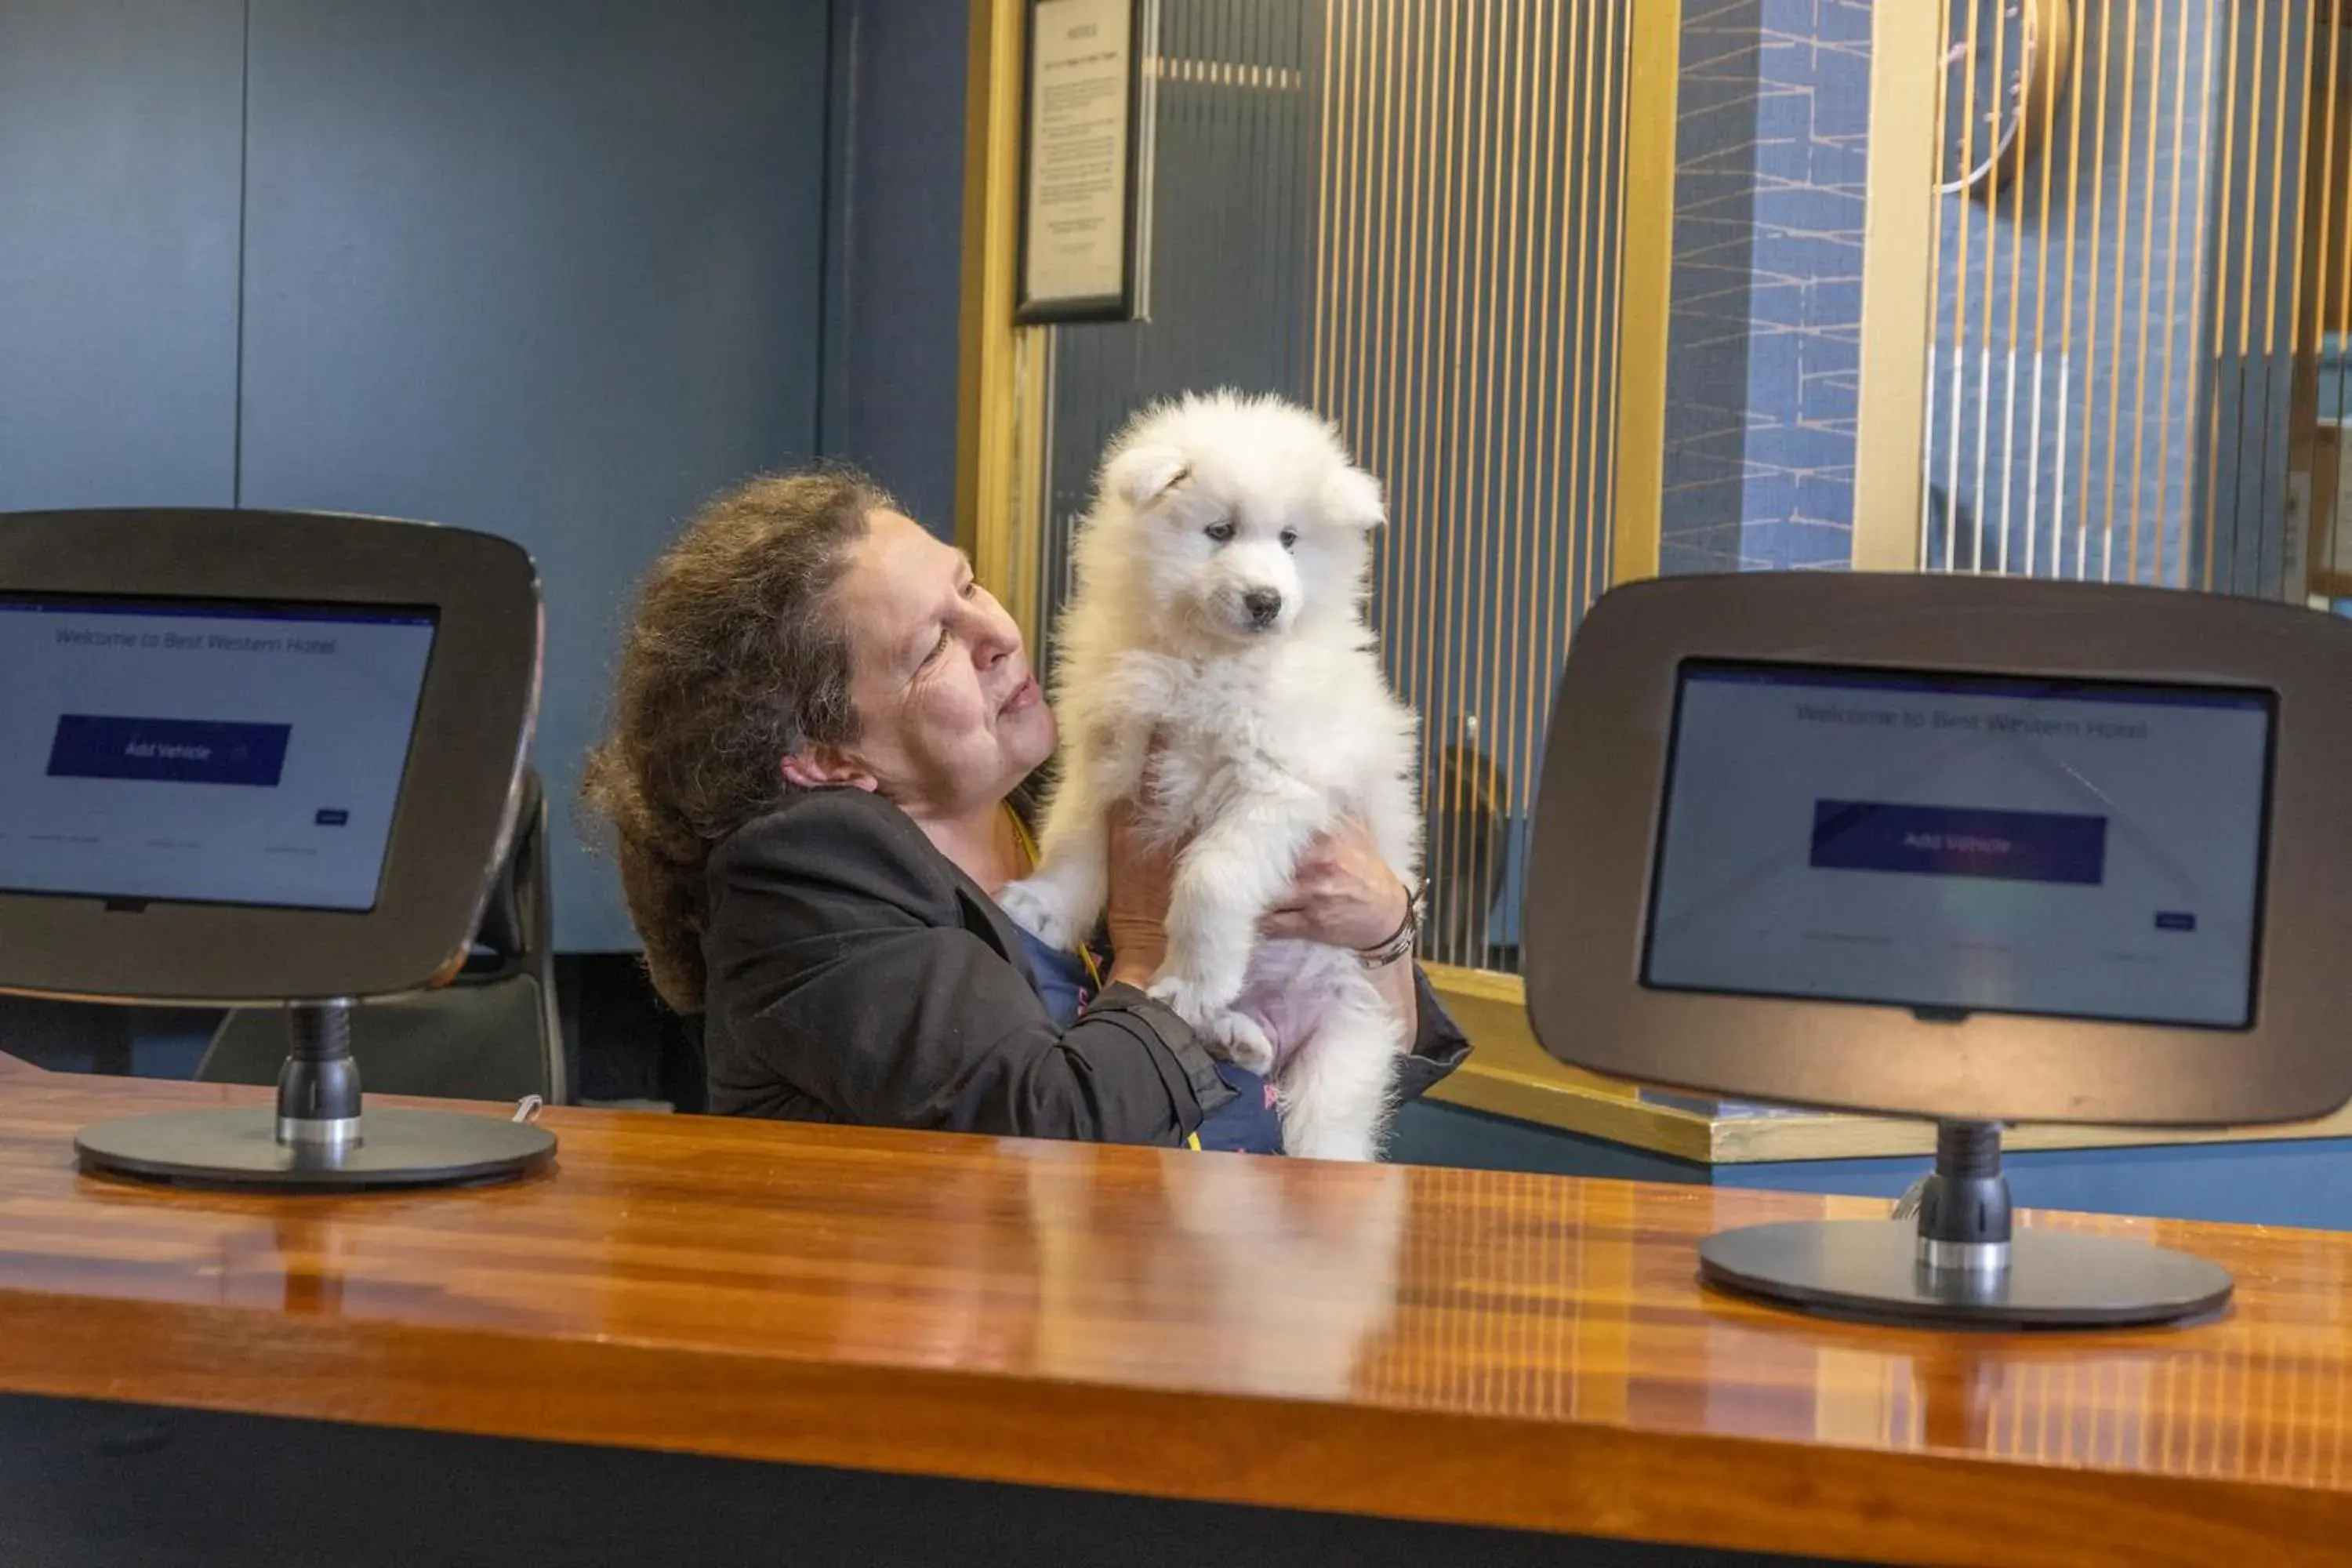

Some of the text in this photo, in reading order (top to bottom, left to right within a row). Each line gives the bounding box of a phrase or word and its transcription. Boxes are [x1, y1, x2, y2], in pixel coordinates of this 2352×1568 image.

[56, 628, 136, 648] Welcome
[141, 632, 159, 648] to
[164, 631, 204, 650] Best
[209, 634, 281, 652] Western
[124, 741, 155, 757] Add
[1904, 832, 1940, 850] Add
